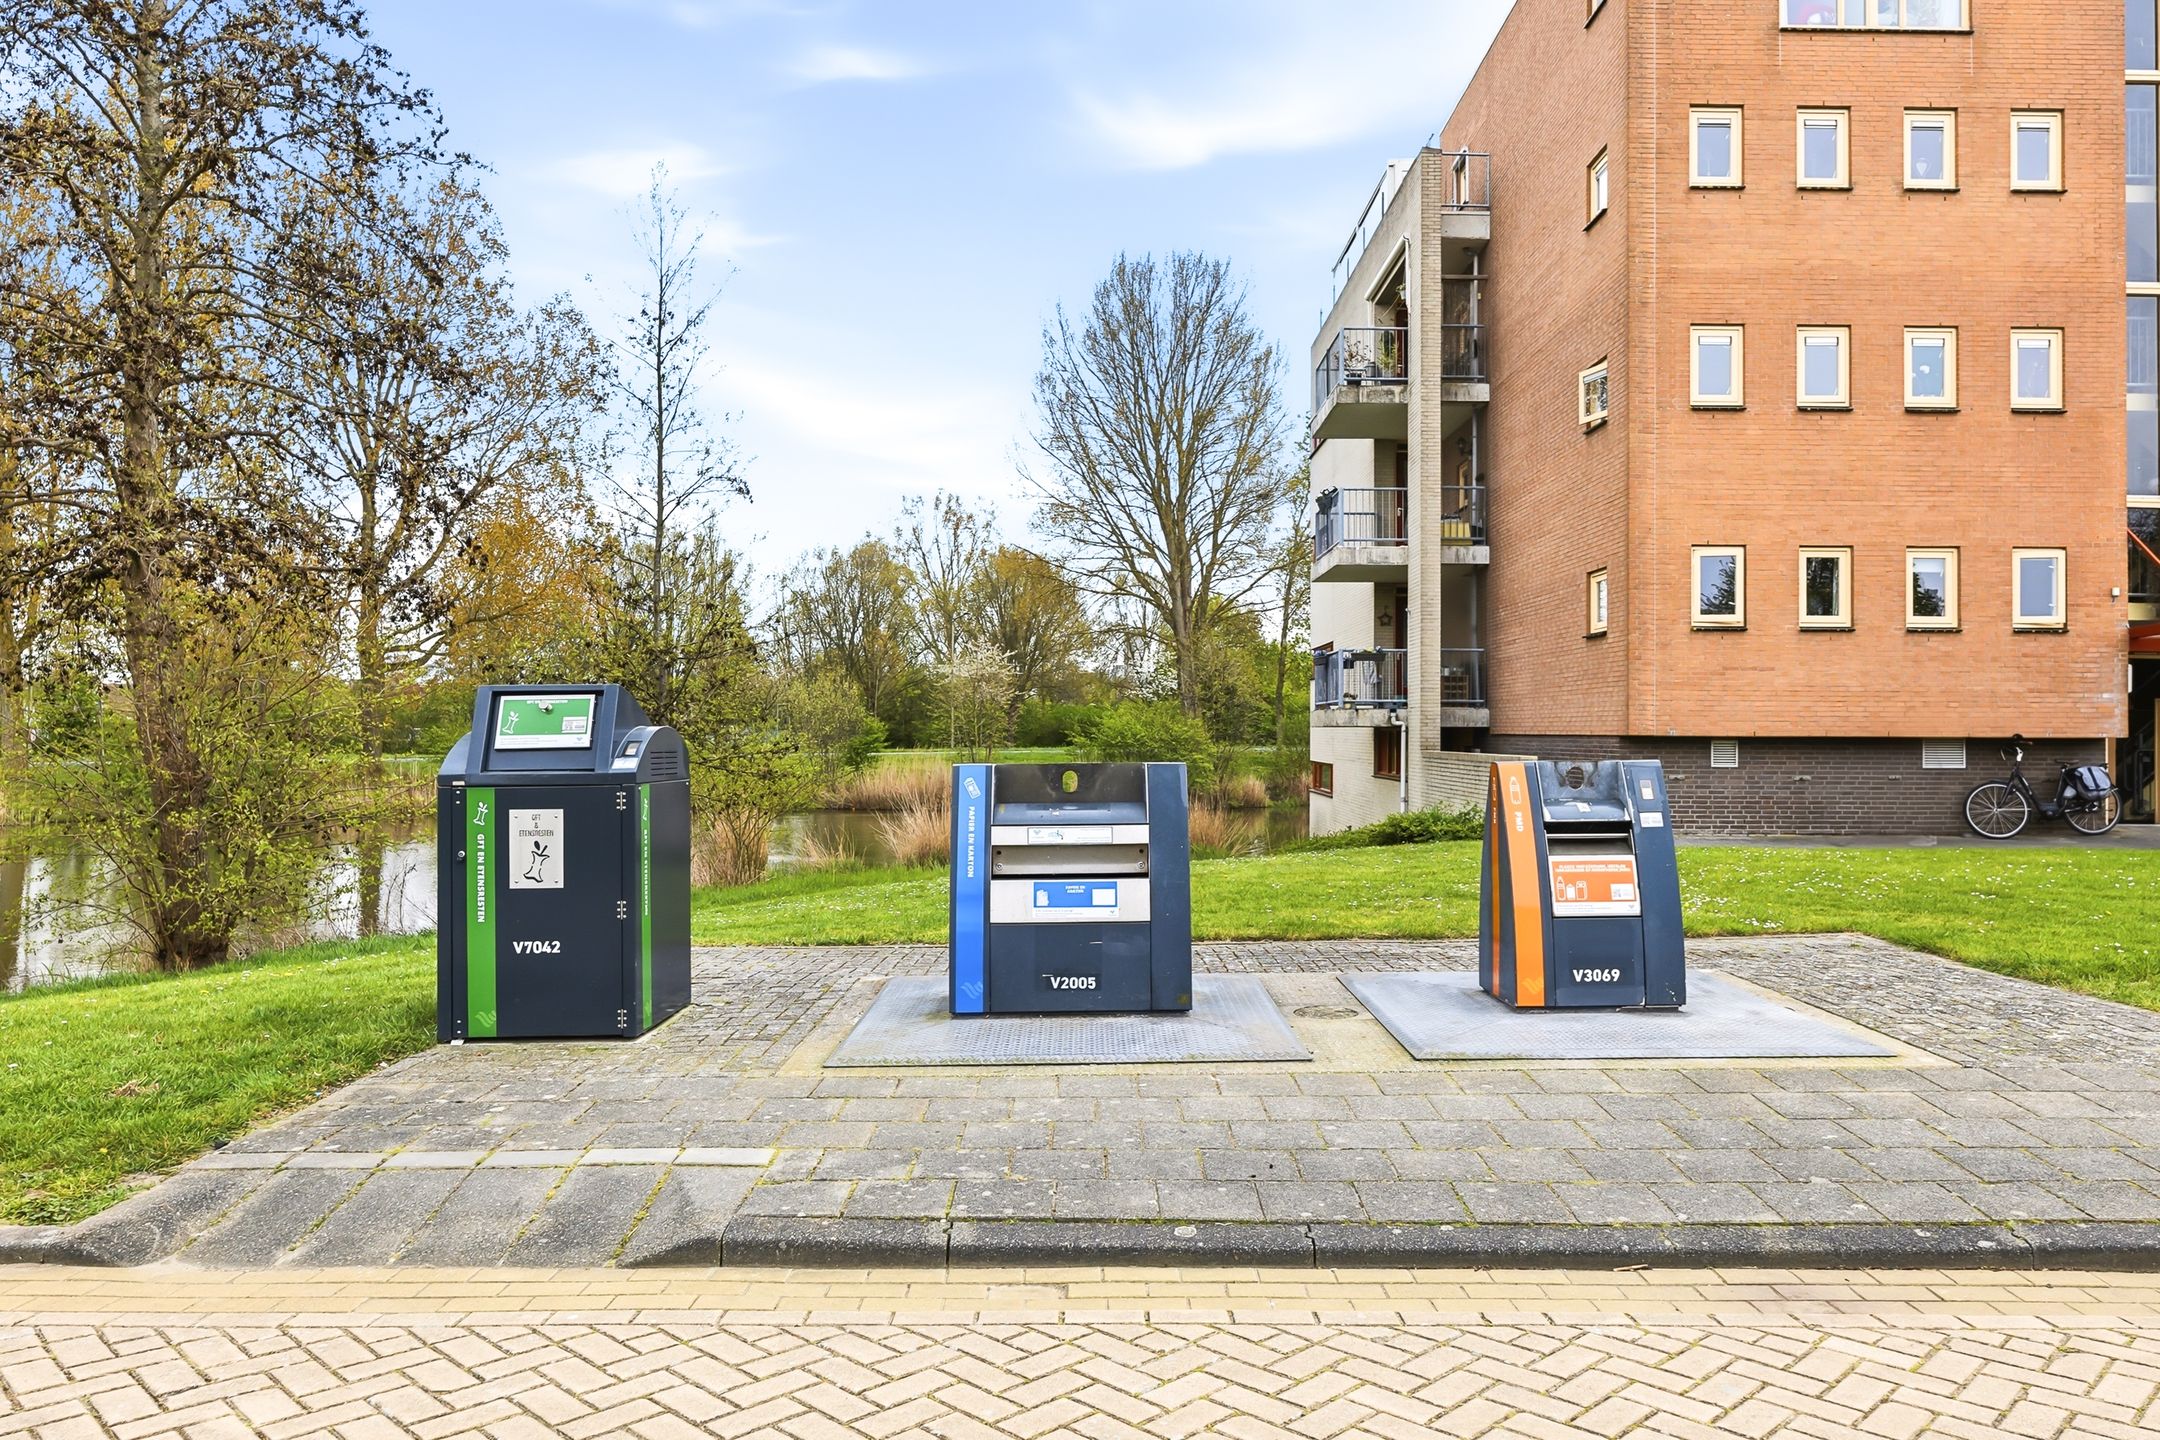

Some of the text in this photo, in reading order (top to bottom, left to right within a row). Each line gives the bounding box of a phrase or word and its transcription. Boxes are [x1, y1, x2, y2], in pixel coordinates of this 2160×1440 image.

[1514, 811, 1524, 832] PMD
[967, 806, 976, 878] PAPIER EN KARTON
[477, 833, 486, 923] GFT EN ETENSRESTEN
[512, 940, 561, 954] V7042
[1050, 976, 1097, 989] V2005
[1572, 968, 1620, 982] V3069
